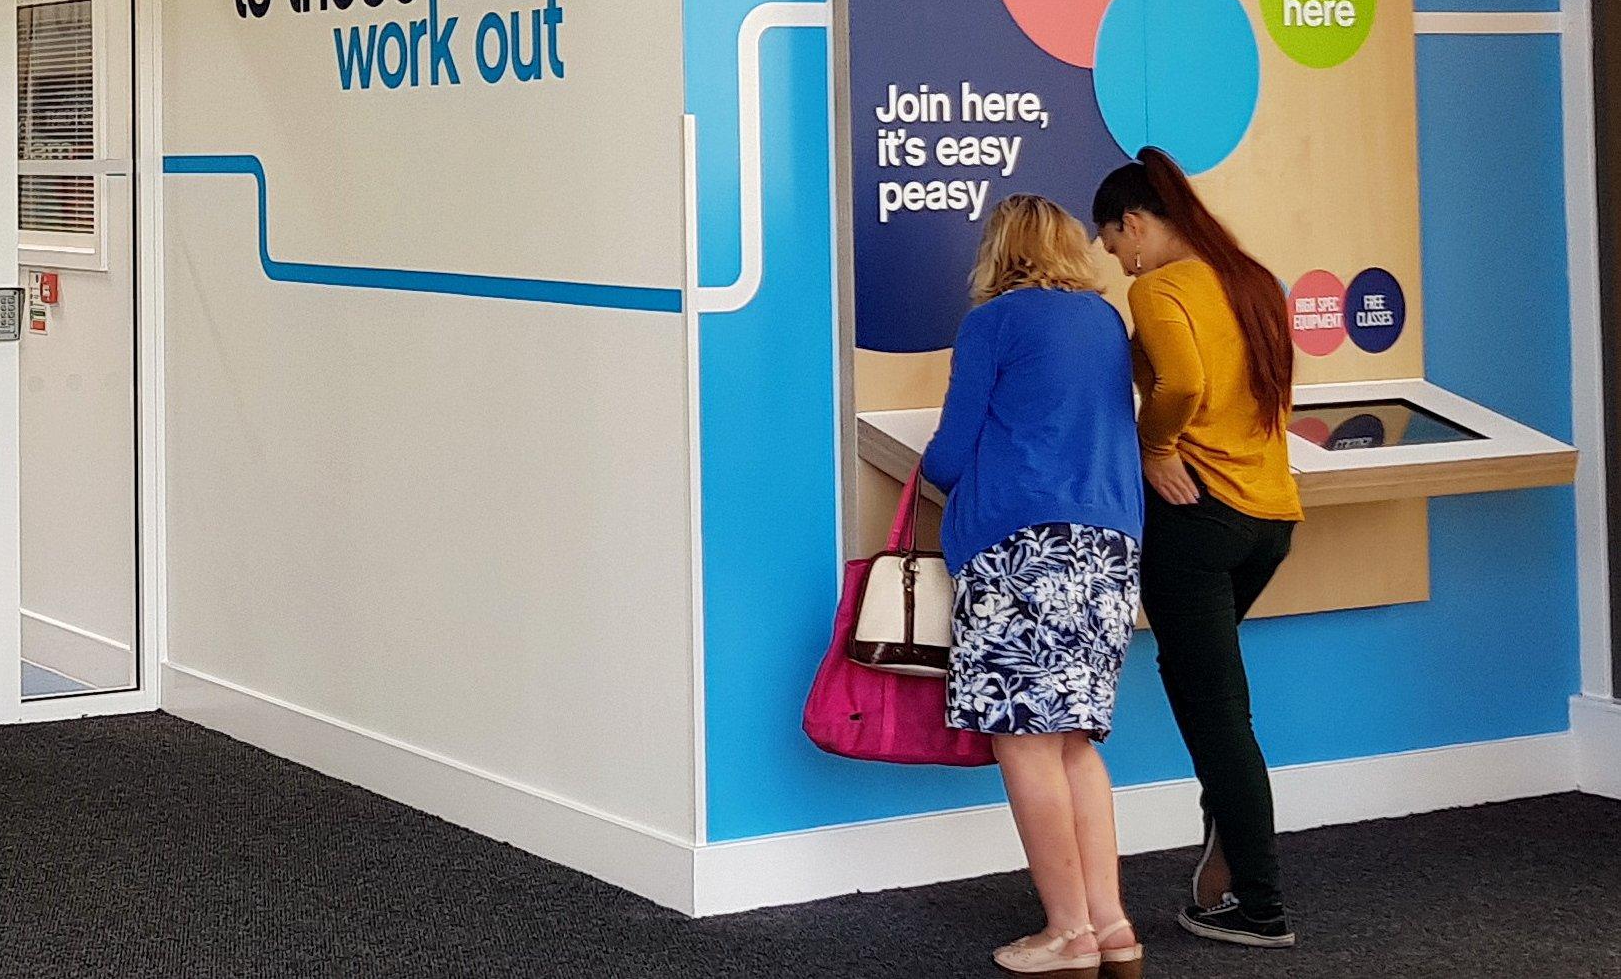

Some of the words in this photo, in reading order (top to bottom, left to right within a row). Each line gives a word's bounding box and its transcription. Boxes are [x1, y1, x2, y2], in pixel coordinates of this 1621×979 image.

[876, 84, 951, 123] Join
[961, 81, 1049, 129] here,
[878, 128, 927, 167] it's
[935, 135, 1023, 177] easy
[878, 180, 990, 223] peasy
[1356, 310, 1394, 327] CLASSES
[1363, 294, 1387, 310] FREE
